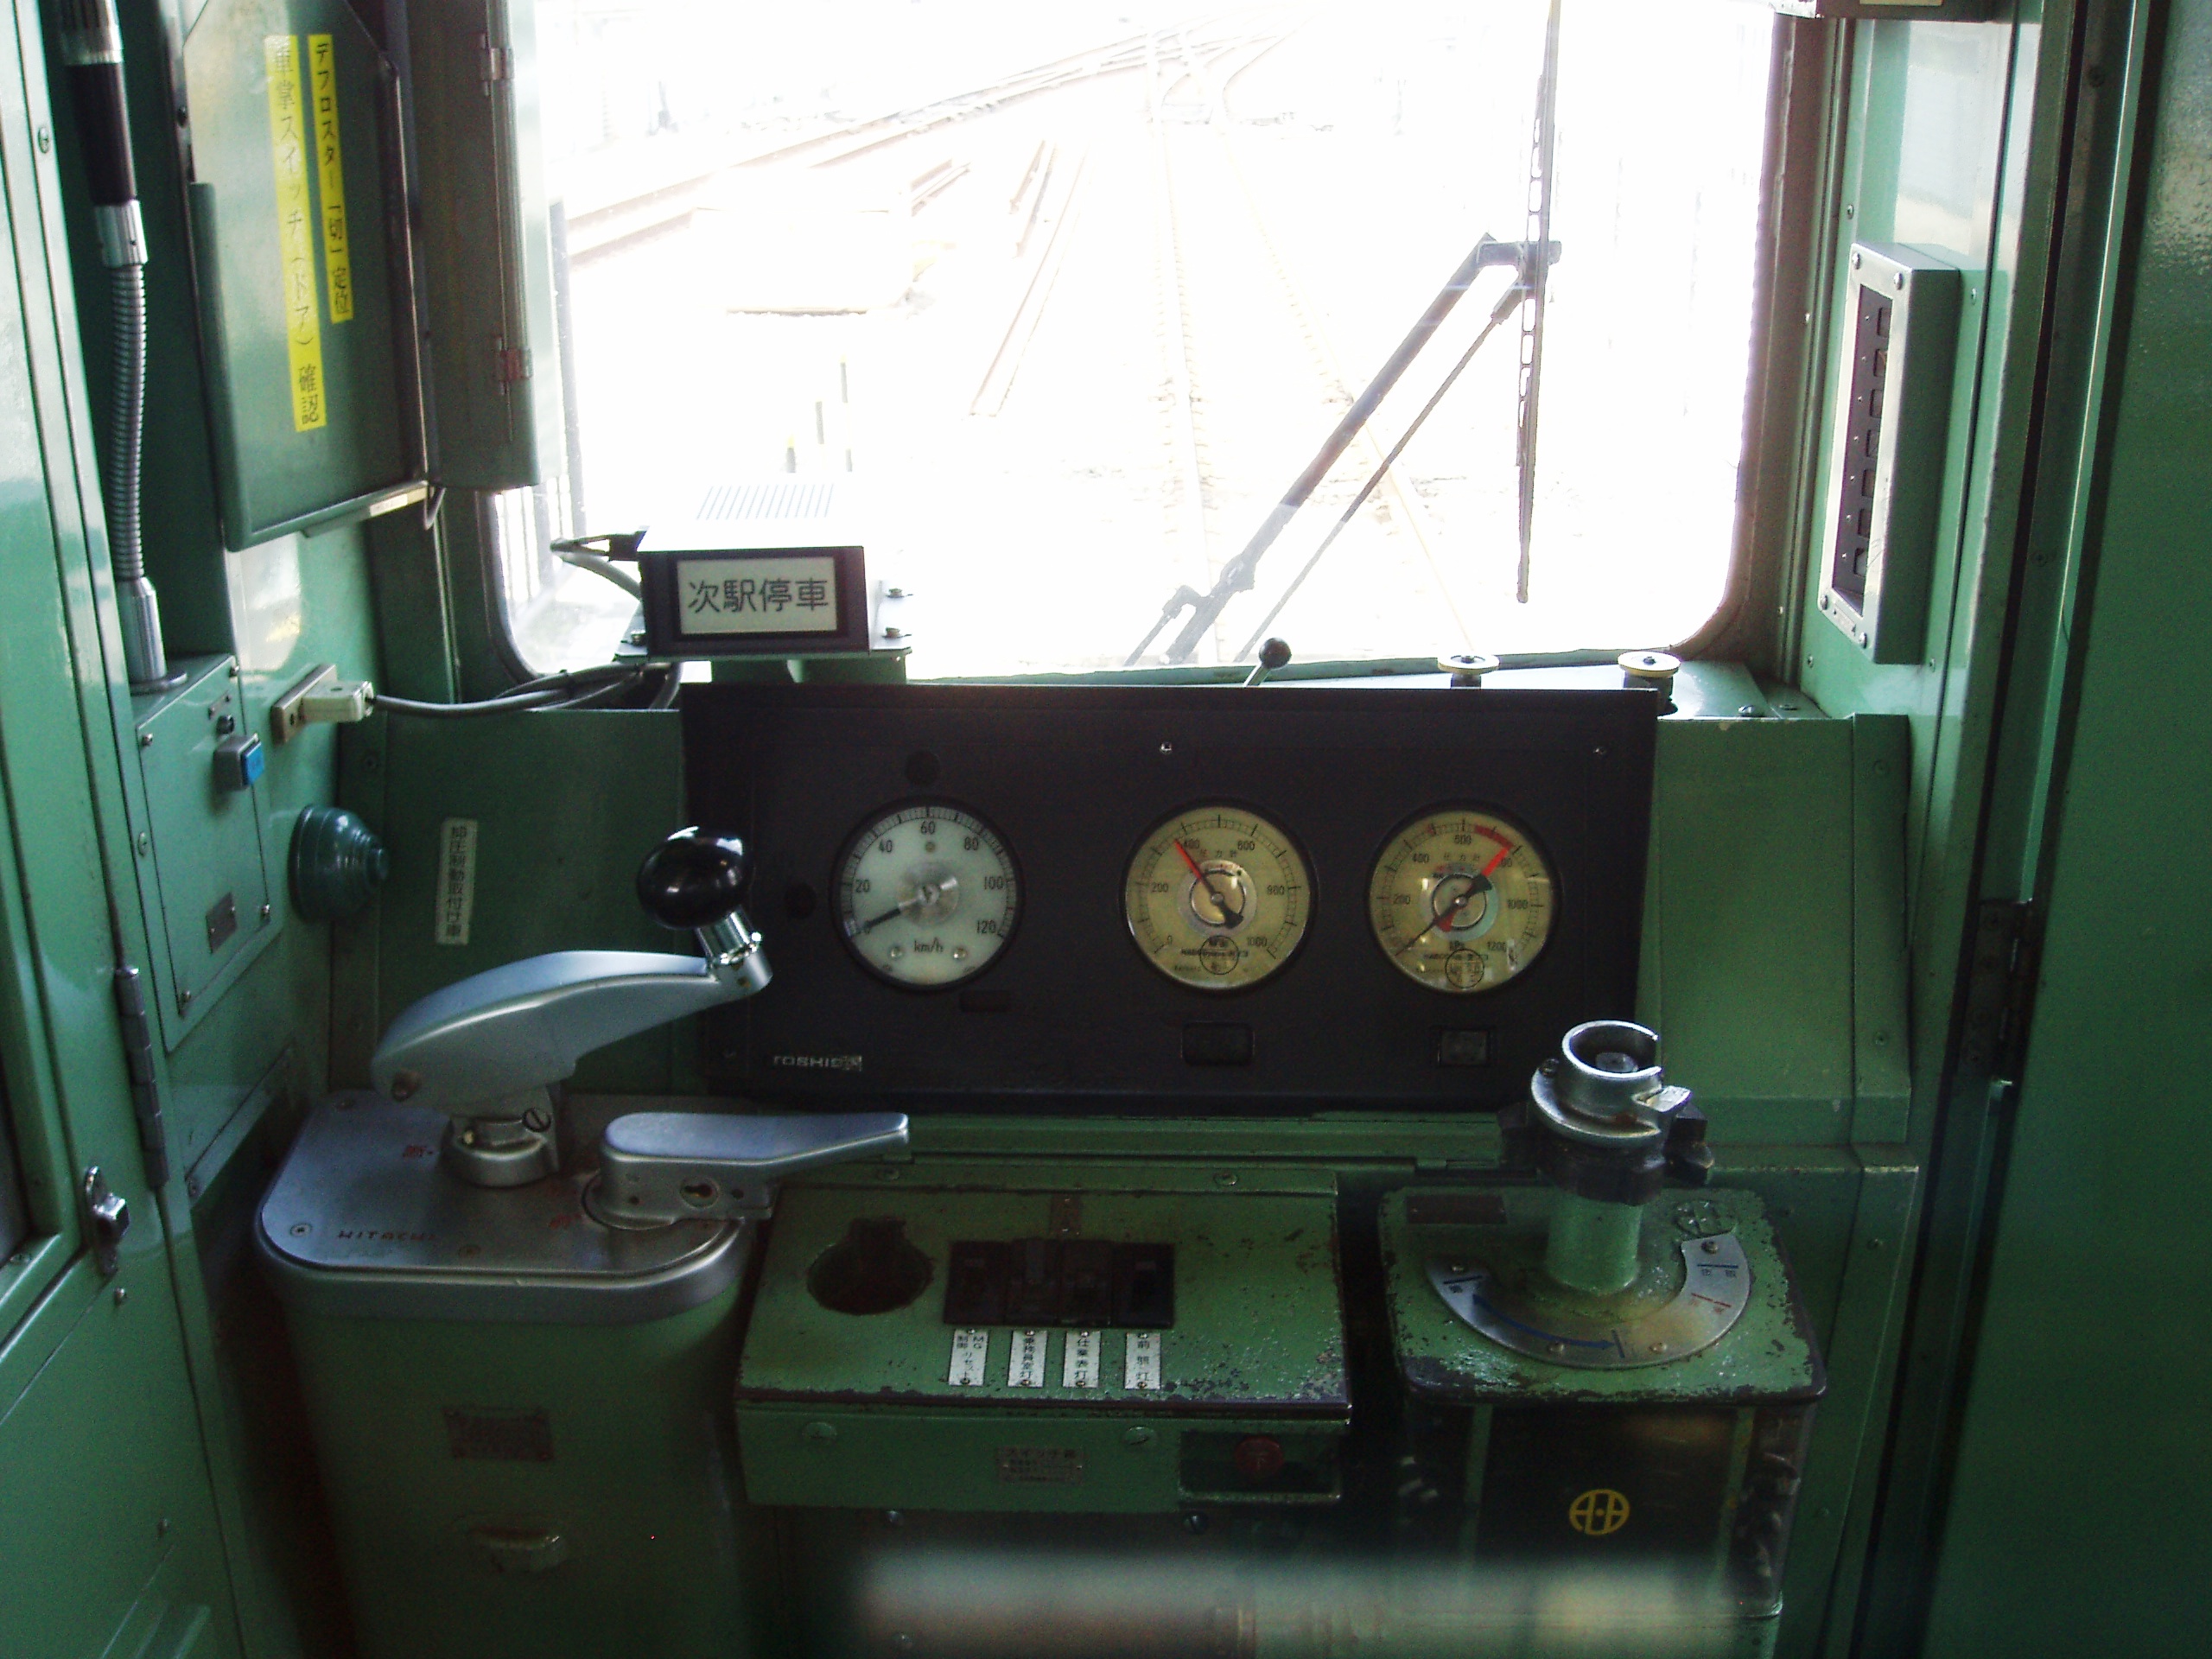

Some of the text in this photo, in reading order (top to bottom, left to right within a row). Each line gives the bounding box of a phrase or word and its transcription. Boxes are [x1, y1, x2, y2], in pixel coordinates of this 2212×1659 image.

[688, 577, 830, 613] 次駅停車
[920, 821, 936, 836] 60
[878, 839, 893, 854] 40
[963, 836, 979, 851] 80
[855, 880, 870, 893] 20
[983, 875, 1004, 890] 100
[976, 920, 997, 934] 120
[913, 937, 944, 953] km/h
